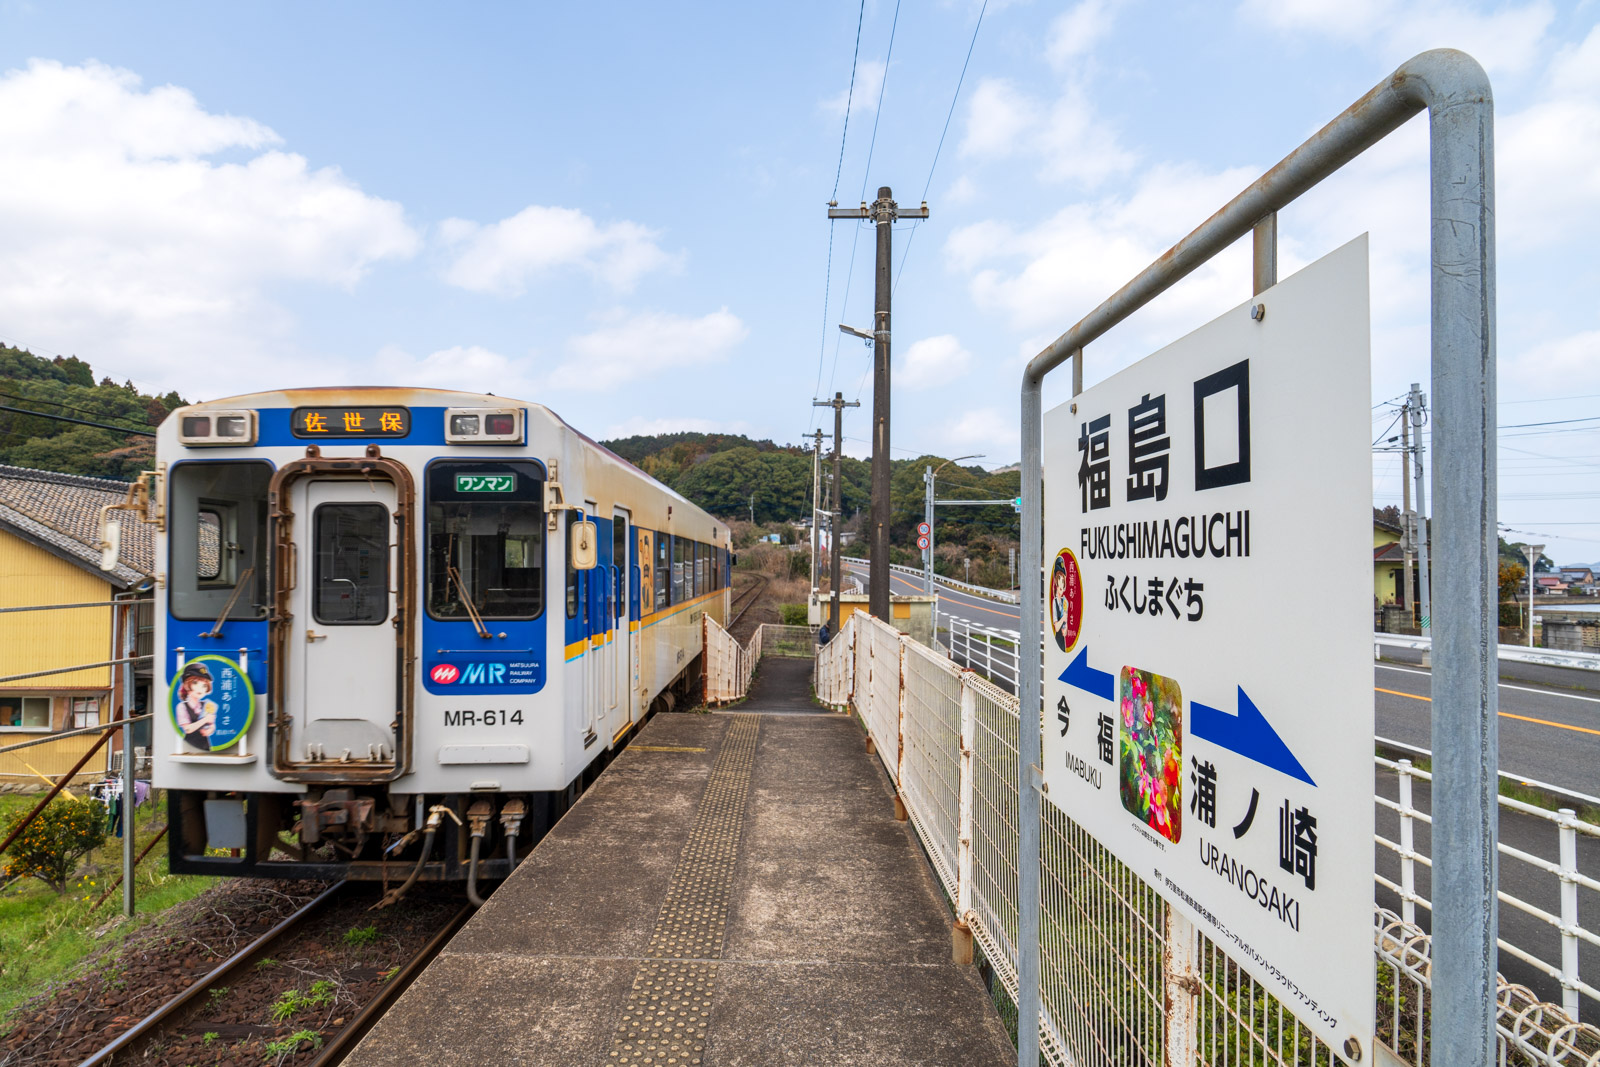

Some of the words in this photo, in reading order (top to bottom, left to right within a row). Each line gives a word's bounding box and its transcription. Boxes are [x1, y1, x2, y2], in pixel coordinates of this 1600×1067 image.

[303, 412, 404, 432] 佐世保
[1077, 358, 1251, 513] 福島口
[459, 477, 511, 491] ワンマン
[1081, 510, 1250, 559] FUKUSHIMAGUCHI
[1105, 574, 1204, 622] ふくしまぐち
[459, 663, 507, 685] MR
[444, 709, 525, 726] MR-614
[1057, 695, 1115, 766] 今福
[1065, 750, 1102, 790] IMABUKU
[1190, 754, 1318, 891] 浦ノ崎
[1200, 837, 1299, 932] URANOSAKI
